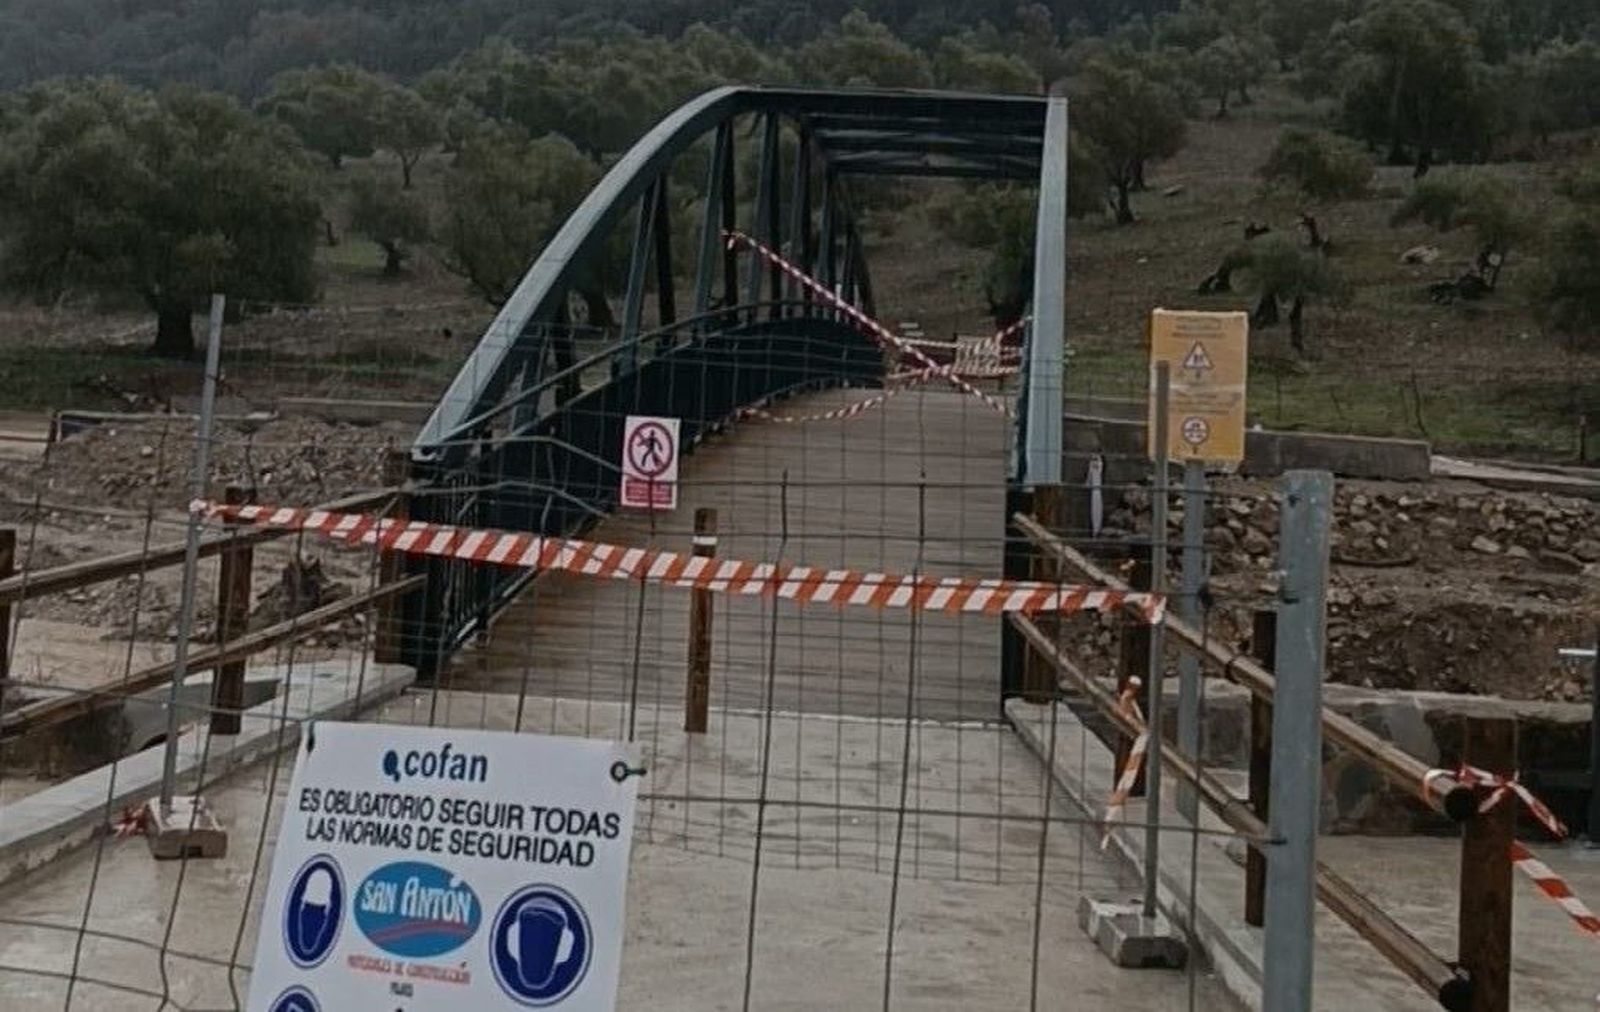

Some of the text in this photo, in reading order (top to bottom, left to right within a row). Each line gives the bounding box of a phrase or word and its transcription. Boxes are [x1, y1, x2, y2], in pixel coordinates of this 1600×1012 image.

[405, 743, 488, 782] cofan
[299, 788, 620, 840] ES OBLIGATORIO SEGUIR TODAS
[306, 817, 595, 867] LAS NORMAS DE SEGURIDAD
[361, 880, 398, 914] SAN
